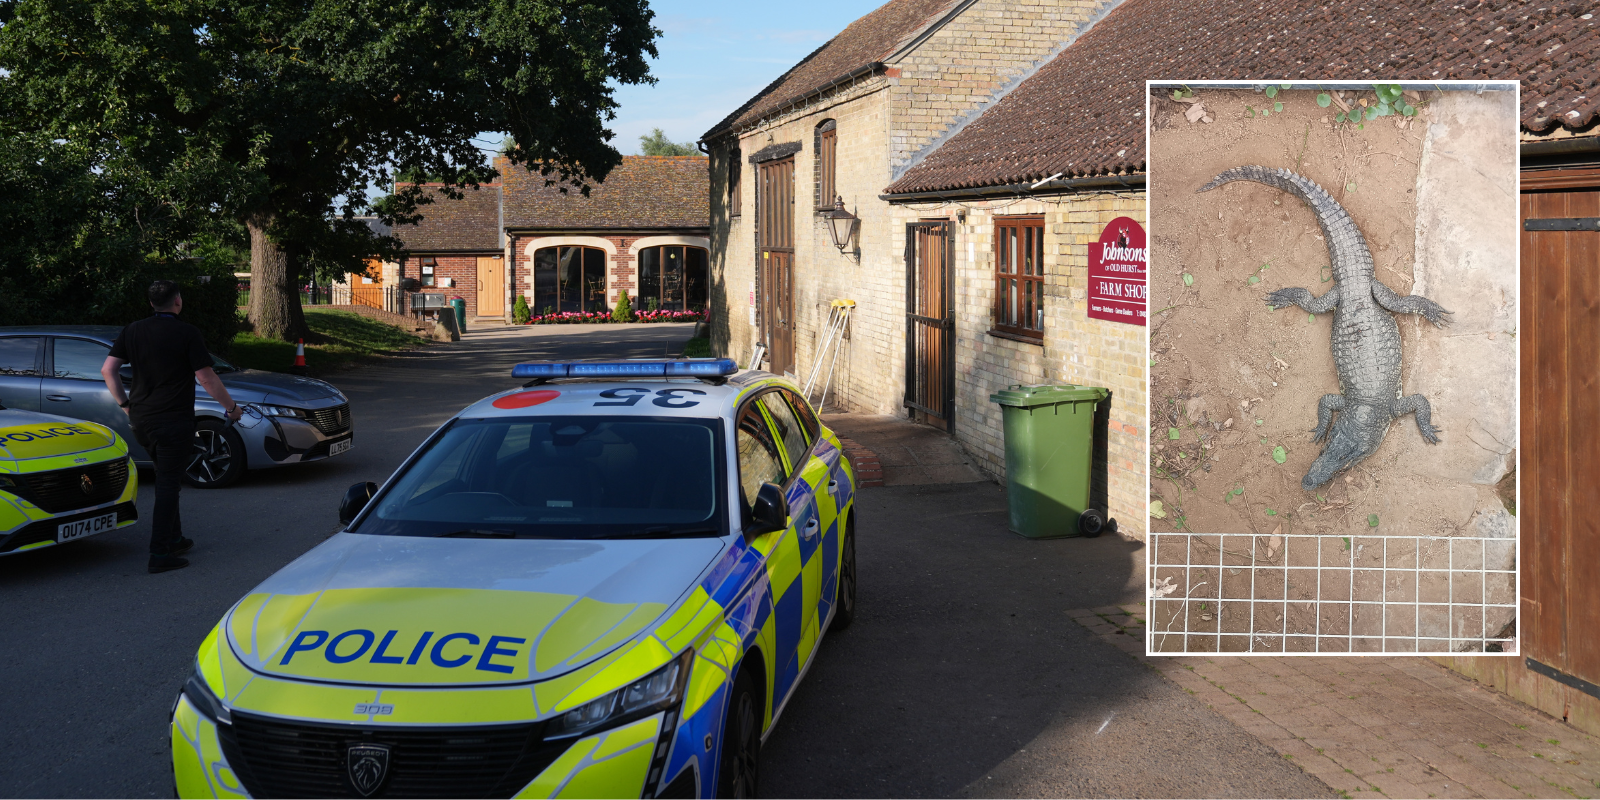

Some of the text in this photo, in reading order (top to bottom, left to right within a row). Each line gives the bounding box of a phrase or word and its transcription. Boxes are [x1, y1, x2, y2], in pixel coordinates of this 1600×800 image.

[1100, 241, 1146, 264] Johnsons
[1110, 264, 1120, 272] OLD
[1121, 264, 1138, 273] HURST
[1100, 281, 1122, 297] FARM
[592, 387, 707, 409] 35
[62, 514, 114, 539] OU74 CPE
[279, 629, 526, 674] POLICE
[355, 705, 393, 715] 308
